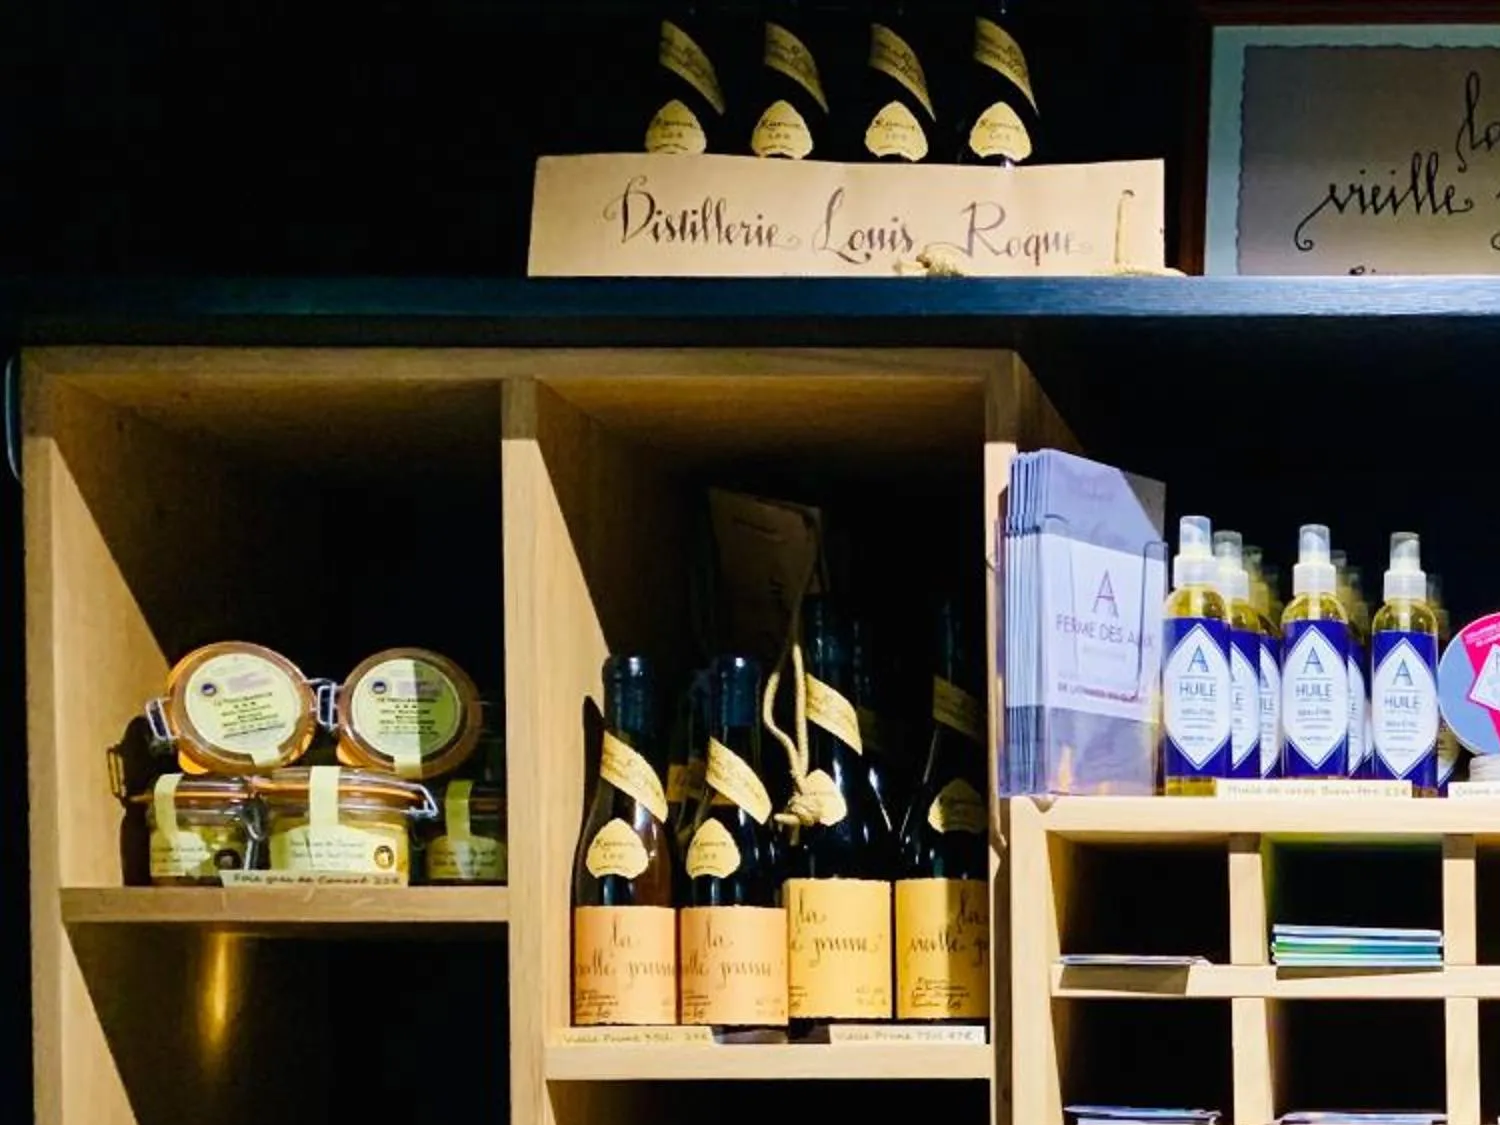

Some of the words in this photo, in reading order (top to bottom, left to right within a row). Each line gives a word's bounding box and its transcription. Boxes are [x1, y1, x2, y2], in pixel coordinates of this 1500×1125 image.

[1295, 152, 1474, 251] vieille
[603, 175, 801, 247] Distillerie
[812, 186, 916, 264] Louis
[959, 200, 1093, 266] Roque
[1179, 681, 1217, 697] HUILE
[1295, 683, 1333, 697] HUILE
[1384, 696, 1422, 709] HUILE
